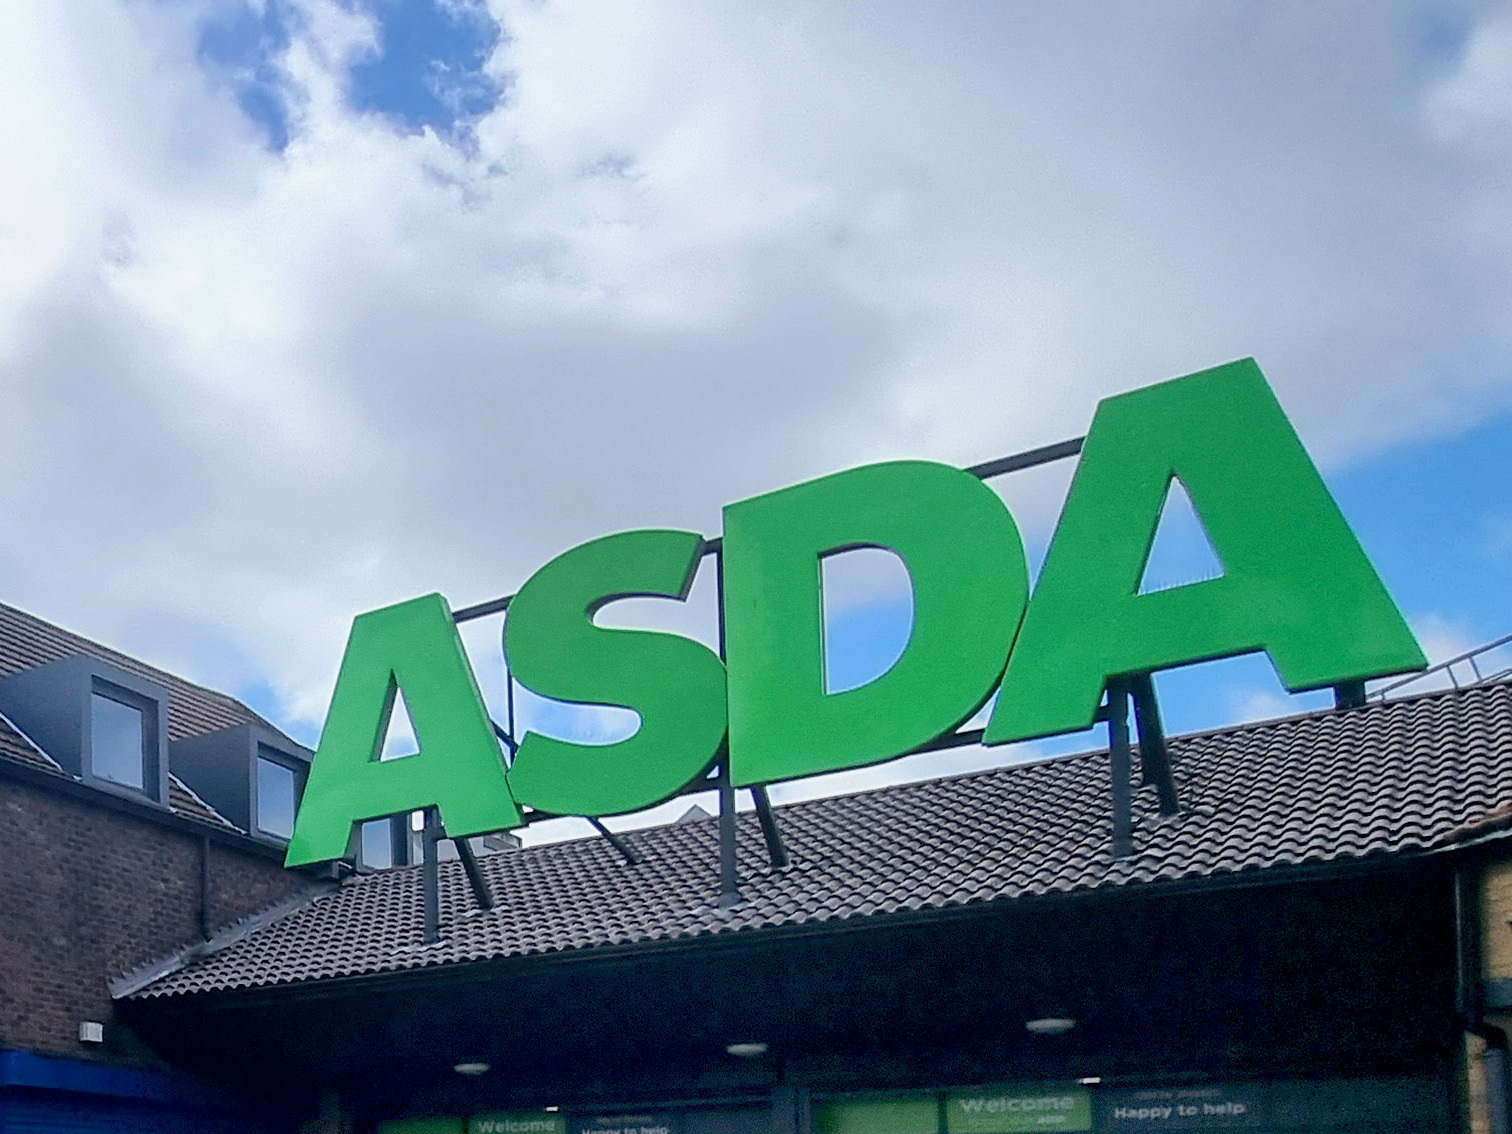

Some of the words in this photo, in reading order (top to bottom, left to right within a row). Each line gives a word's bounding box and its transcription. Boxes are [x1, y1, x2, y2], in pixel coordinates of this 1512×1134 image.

[285, 357, 1427, 867] ASDA
[959, 1097, 1074, 1112] Welcome
[1114, 1106, 1172, 1120] Happy
[1178, 1104, 1198, 1116] to
[1203, 1101, 1245, 1115] help
[478, 1120, 556, 1134] Welcome
